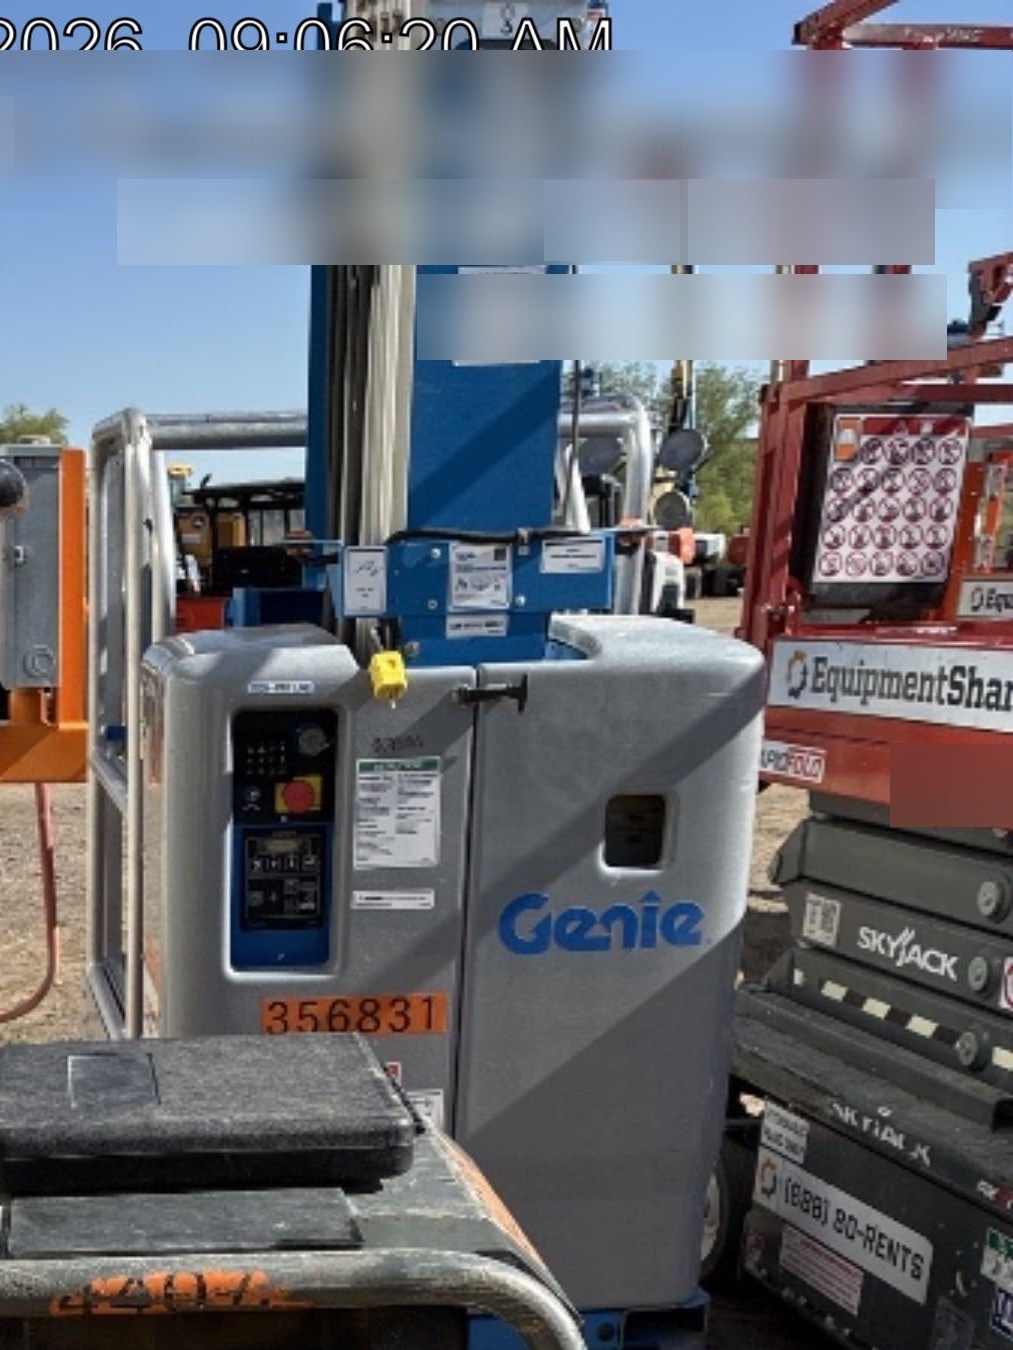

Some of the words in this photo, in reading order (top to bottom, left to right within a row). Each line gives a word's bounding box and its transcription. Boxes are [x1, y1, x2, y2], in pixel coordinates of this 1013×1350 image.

[499, 890, 705, 954] Genie
[857, 925, 960, 982] SKYJACK
[266, 996, 435, 1034] 356831
[783, 1175, 830, 1226] (888)
[832, 1206, 926, 1282] 80-RENTS
